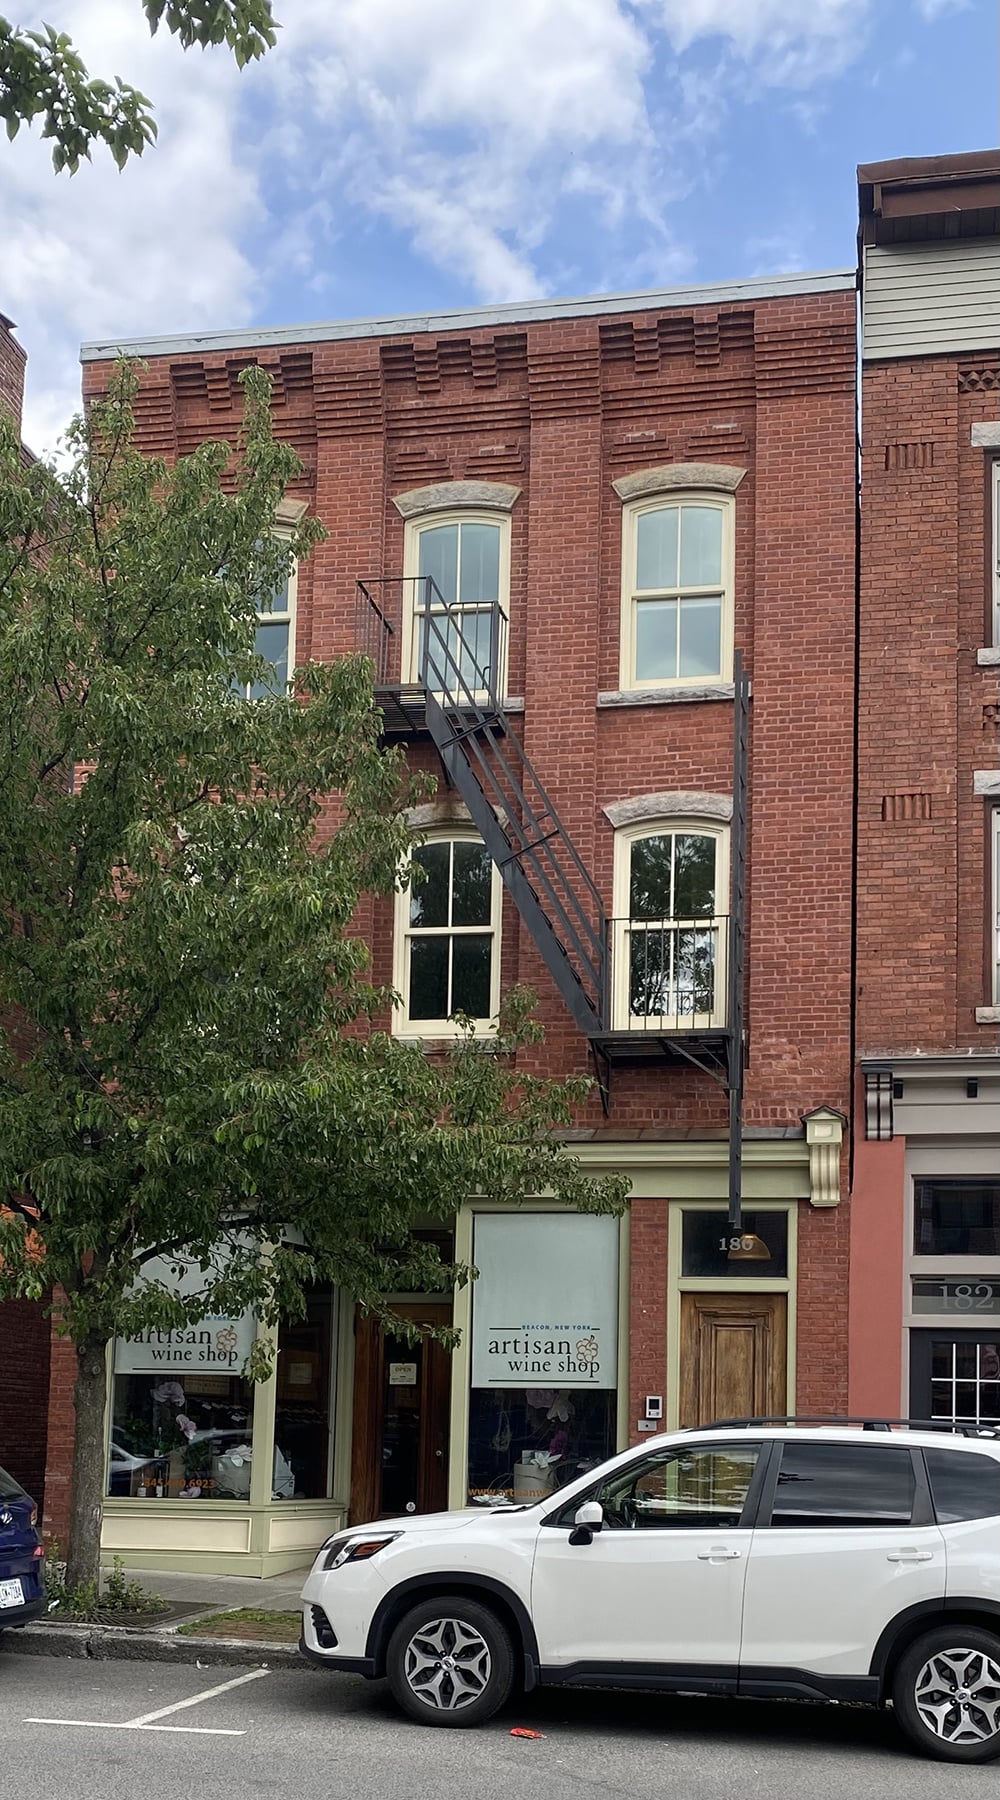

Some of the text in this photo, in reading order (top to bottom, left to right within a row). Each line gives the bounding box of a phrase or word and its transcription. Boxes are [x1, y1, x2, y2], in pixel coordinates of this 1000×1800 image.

[719, 1237, 754, 1251] 180
[939, 1284, 994, 1309] 182
[133, 1329, 212, 1344] artisan
[488, 1333, 572, 1354] artisan
[152, 1344, 238, 1367] wine shop
[508, 1355, 600, 1378] wine shop
